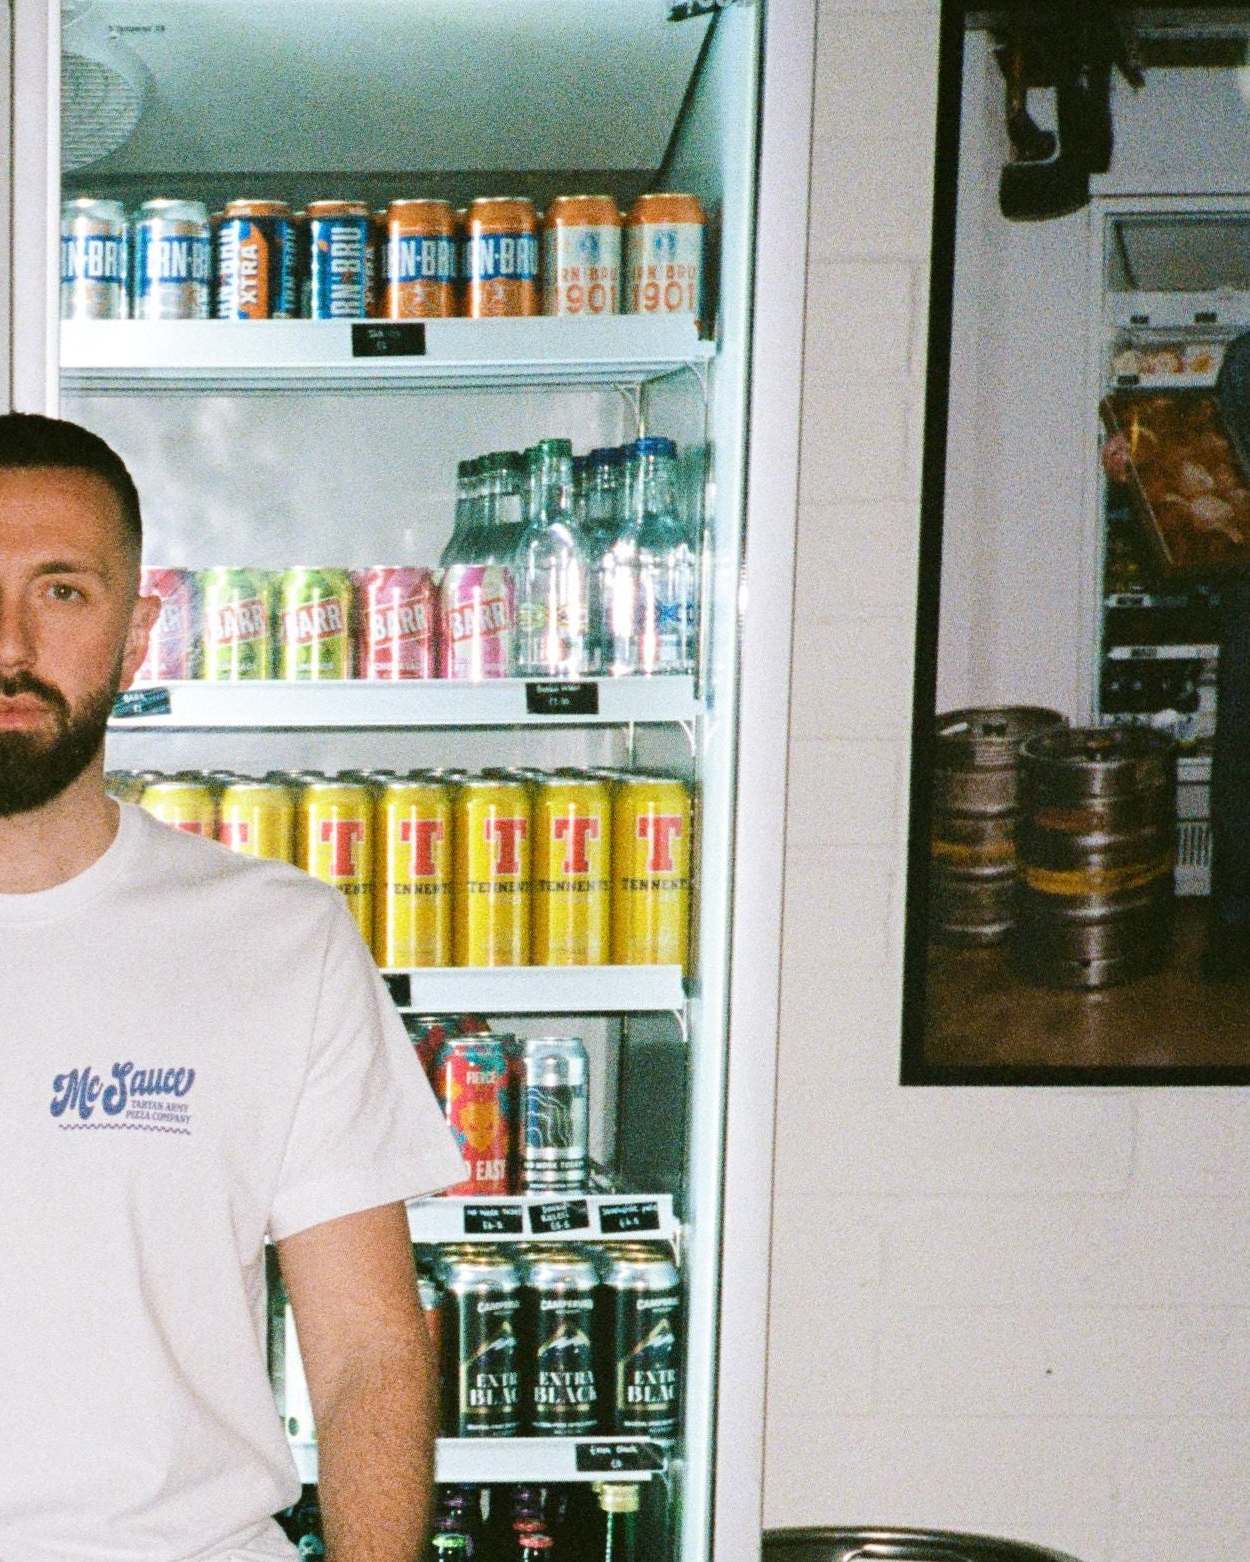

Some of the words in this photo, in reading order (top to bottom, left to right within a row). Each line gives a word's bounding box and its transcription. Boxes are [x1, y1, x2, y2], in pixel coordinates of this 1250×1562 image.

[240, 244, 258, 304] XTRA
[632, 281, 695, 312] 1901
[374, 602, 427, 638] BARR
[451, 602, 506, 638] BARR
[321, 820, 365, 877] T
[401, 820, 443, 876] T
[486, 819, 528, 875] T
[554, 817, 599, 873] T
[638, 815, 683, 871] T
[126, 1110, 151, 1119] PIZZA
[152, 1111, 191, 1124] COMPANY
[131, 1100, 163, 1110] TARTAN
[165, 1103, 189, 1113] ARMY
[539, 1371, 594, 1387] EXTRA
